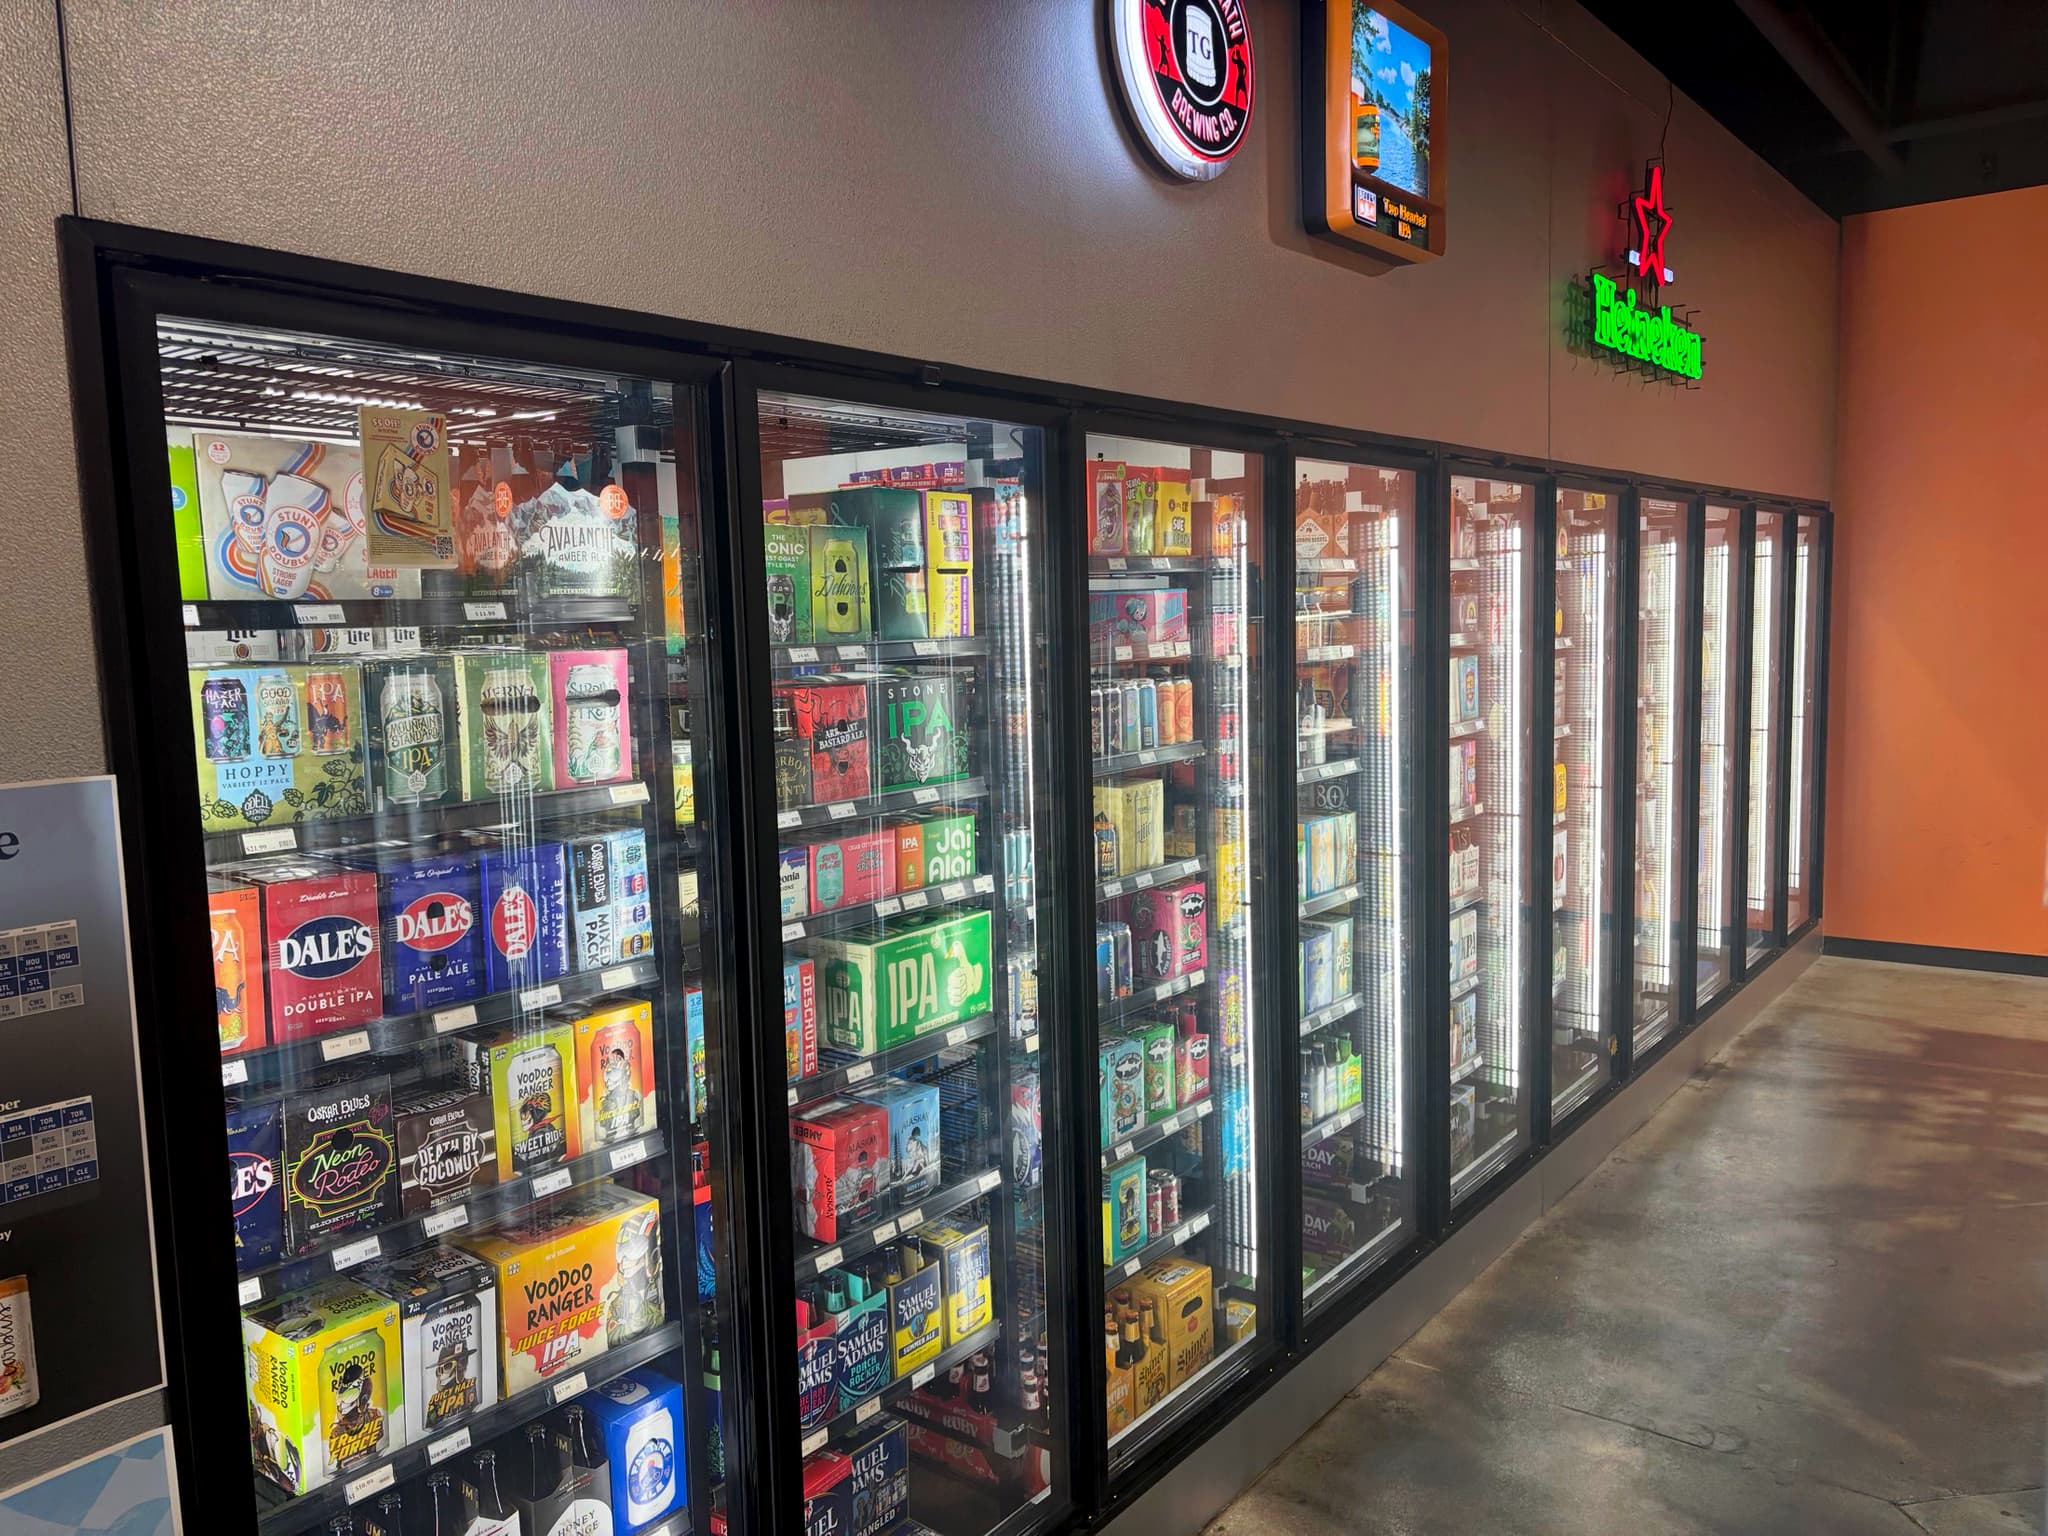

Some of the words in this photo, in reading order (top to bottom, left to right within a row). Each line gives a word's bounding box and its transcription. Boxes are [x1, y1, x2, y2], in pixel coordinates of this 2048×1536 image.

[1188, 29, 1211, 60] TG
[1171, 87, 1220, 142] BREWING
[1218, 107, 1238, 138] CO.
[1383, 197, 1398, 216] Two
[1399, 204, 1427, 227] Hearted
[1398, 219, 1411, 239] IPA
[1592, 272, 1702, 380] Heineken
[278, 512, 315, 530] STUNT
[539, 525, 615, 553] AVALANCHE
[765, 542, 804, 555] ONIC
[270, 545, 310, 566] DOUBLE
[559, 552, 587, 563] AMBER
[272, 568, 297, 580] STRONG
[273, 577, 293, 587] LAGER
[815, 573, 867, 597] Delicious
[346, 630, 371, 645] Lite
[392, 628, 416, 643] Lite
[205, 688, 242, 703] HAZER
[213, 700, 237, 709] TAG
[261, 688, 291, 698] GOOD
[311, 682, 345, 704] IPA
[888, 683, 946, 699] STONE
[388, 715, 437, 738] MOUNTAIN
[888, 696, 954, 739] IPA
[390, 727, 441, 748] STANDARD
[819, 734, 849, 750] BASTARD
[225, 764, 289, 780] HOPPY
[401, 747, 433, 772] IPA
[222, 781, 256, 789] VARIETY
[271, 777, 291, 785] PACK
[243, 795, 270, 810] ODELL
[902, 838, 918, 849] IPA
[936, 824, 973, 853] Jai
[426, 866, 454, 877] Original
[929, 852, 971, 883] Alai
[554, 878, 564, 911] ALE
[556, 913, 566, 949] PALE
[585, 920, 599, 966] PACK
[598, 913, 611, 967] MIXED
[278, 926, 374, 970] DALE'S
[409, 968, 441, 985] PALE
[446, 962, 469, 976] ALE
[284, 993, 345, 1017] DOUBLE
[350, 990, 374, 1003] IPA
[888, 952, 938, 1028] IPA
[828, 986, 861, 1031] IPA
[803, 975, 814, 1073] DESCHUTES
[517, 1066, 553, 1085] VOODOO
[518, 1079, 554, 1100] RANGER
[307, 1104, 339, 1123] OSKAR
[340, 1094, 371, 1114] BLUES
[514, 1131, 544, 1155] SWEET
[793, 1125, 823, 1142] AMBER
[417, 1140, 458, 1167] DEATH
[461, 1132, 480, 1152] BY
[1308, 1148, 1336, 1166] DAY
[308, 1143, 371, 1184] Neon
[313, 1150, 381, 1199] Rodeo
[419, 1150, 481, 1187] COCONUT
[823, 1174, 834, 1220] ALASKAN
[1304, 1214, 1331, 1233] DAY
[524, 1263, 593, 1305] VOODOO
[527, 1282, 594, 1331] RANGER
[898, 1284, 936, 1315] SAMUEL
[903, 1297, 934, 1325] ADAMS
[432, 1313, 472, 1337] VOODOO
[432, 1325, 472, 1352] RANGER
[512, 1323, 555, 1357] JUICE
[557, 1303, 604, 1336] FORCE
[837, 1318, 887, 1359] SAMUEL
[542, 1328, 580, 1364] IPA
[842, 1336, 885, 1373] ADAMS
[1177, 1328, 1209, 1373] Shiner
[329, 1350, 376, 1377] VOODOO
[849, 1363, 880, 1388] ROCKER
[850, 1355, 877, 1377] PORCH
[269, 1354, 280, 1405] RANGER
[278, 1359, 288, 1409] VOODOO
[438, 1392, 464, 1417] IPA
[942, 1414, 979, 1438] RUBY
[329, 1433, 379, 1465] FORCE
